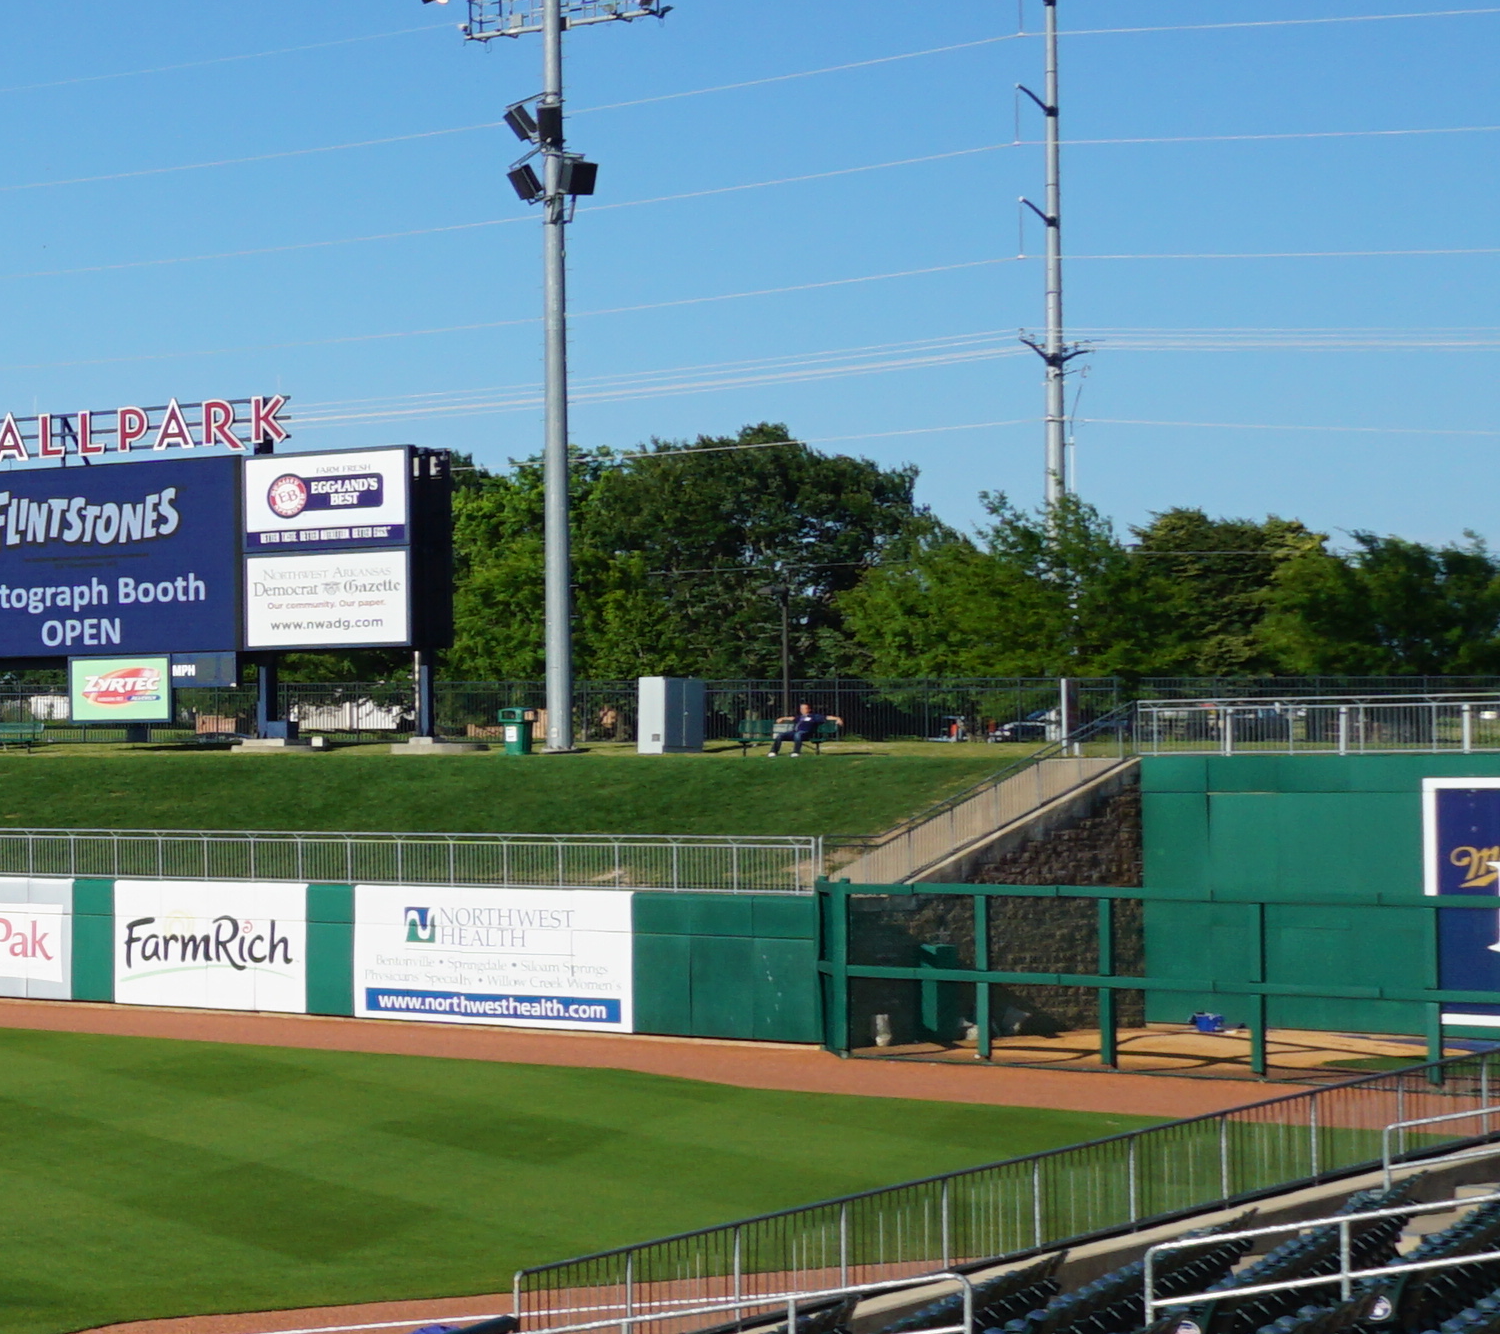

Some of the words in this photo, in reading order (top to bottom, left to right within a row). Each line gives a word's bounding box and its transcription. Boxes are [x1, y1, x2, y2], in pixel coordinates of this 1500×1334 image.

[330, 493, 359, 506] BEST
[118, 572, 206, 605] Booth
[253, 581, 319, 597] Democrat
[343, 579, 401, 595] Gazette
[267, 602, 283, 610] Our
[286, 600, 337, 610] community.
[339, 599, 355, 607] Our
[357, 599, 387, 609] paper.
[41, 618, 121, 646] OPEN
[271, 618, 383, 630] www.nwadg.com
[172, 665, 196, 677] MPH
[84, 675, 161, 694] ZYRTEC
[439, 906, 575, 929] NORTHWEST
[124, 915, 293, 971] FarmRich
[439, 927, 527, 948] HEALTH
[375, 955, 435, 967] Bentonville
[447, 956, 508, 972] Springdale
[520, 959, 560, 972] Siloam
[562, 961, 609, 976] Springs
[424, 972, 473, 986] Specialty
[486, 974, 527, 987] Willow
[529, 976, 561, 989] Creek
[378, 993, 607, 1020] www.northwesthealth.com
